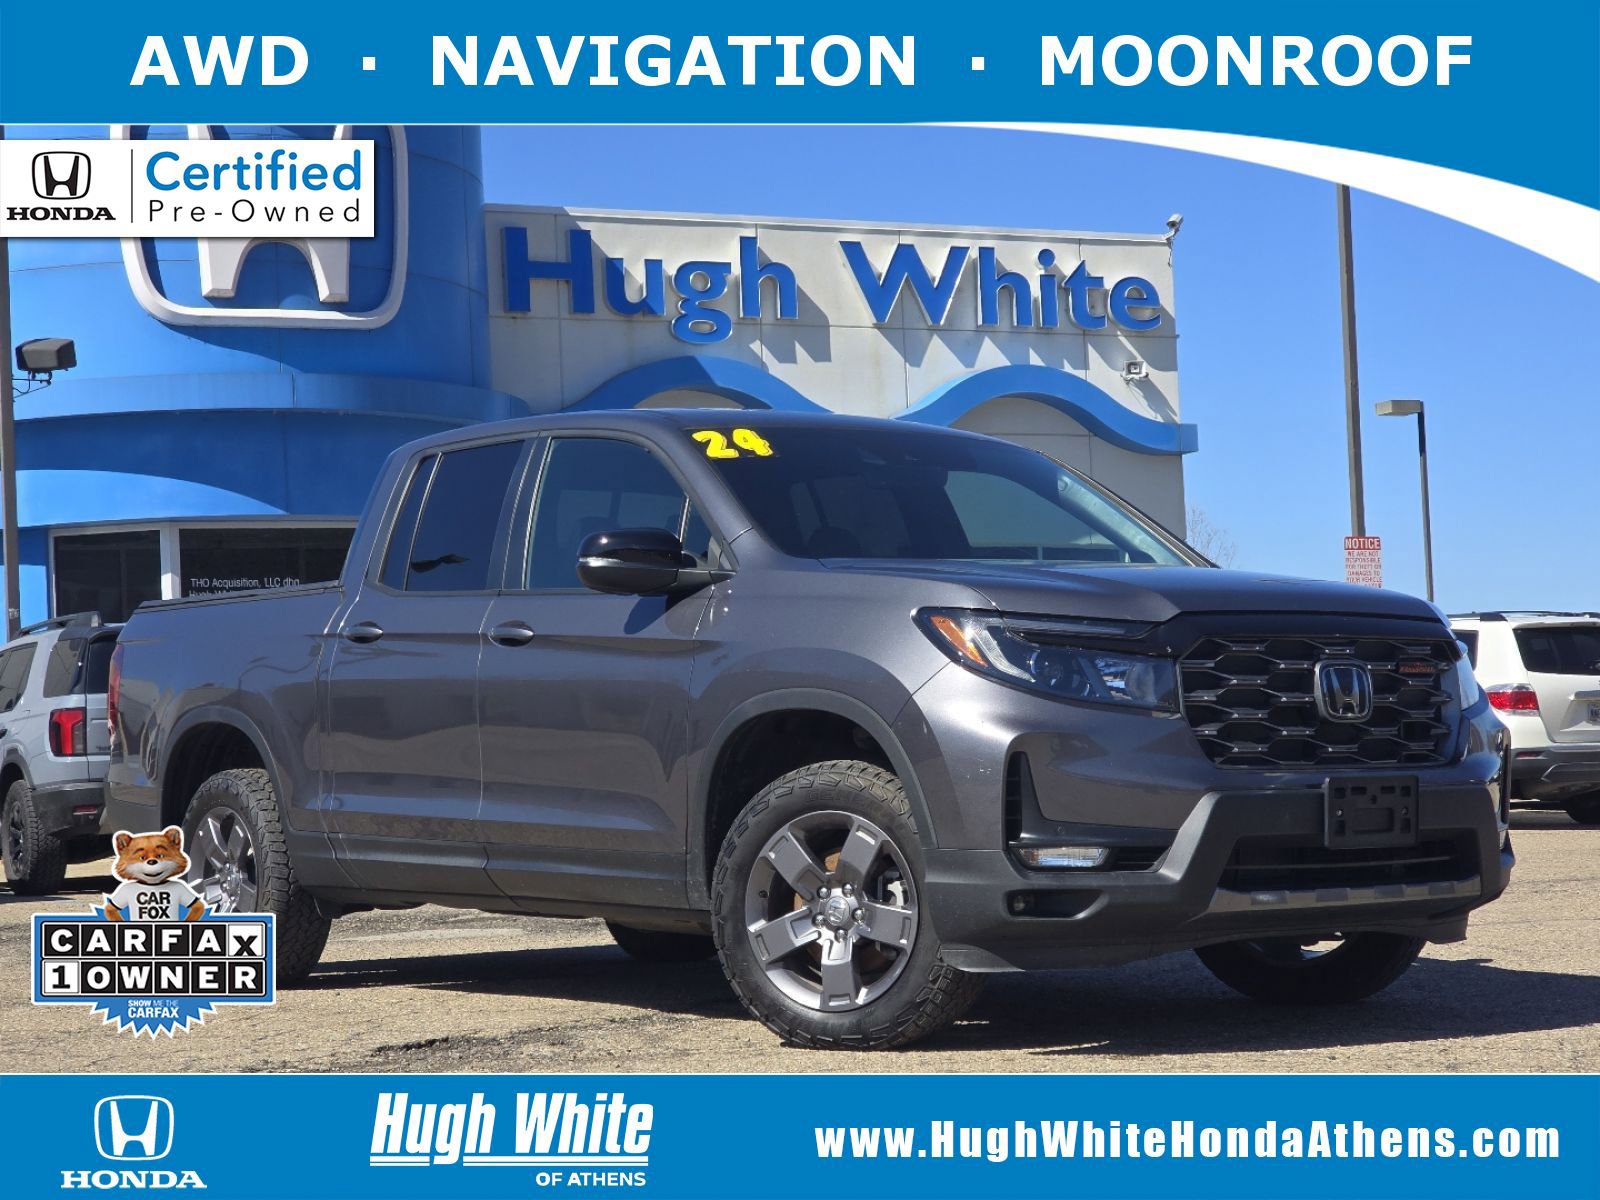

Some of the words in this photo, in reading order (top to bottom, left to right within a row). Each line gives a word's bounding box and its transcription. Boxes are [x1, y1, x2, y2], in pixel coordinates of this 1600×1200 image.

[503, 227, 799, 345] Hugh
[839, 240, 1162, 331] White
[692, 428, 774, 458] 24
[1345, 538, 1380, 549] NOTICE
[190, 578, 210, 588] THO
[264, 577, 281, 588] LLC
